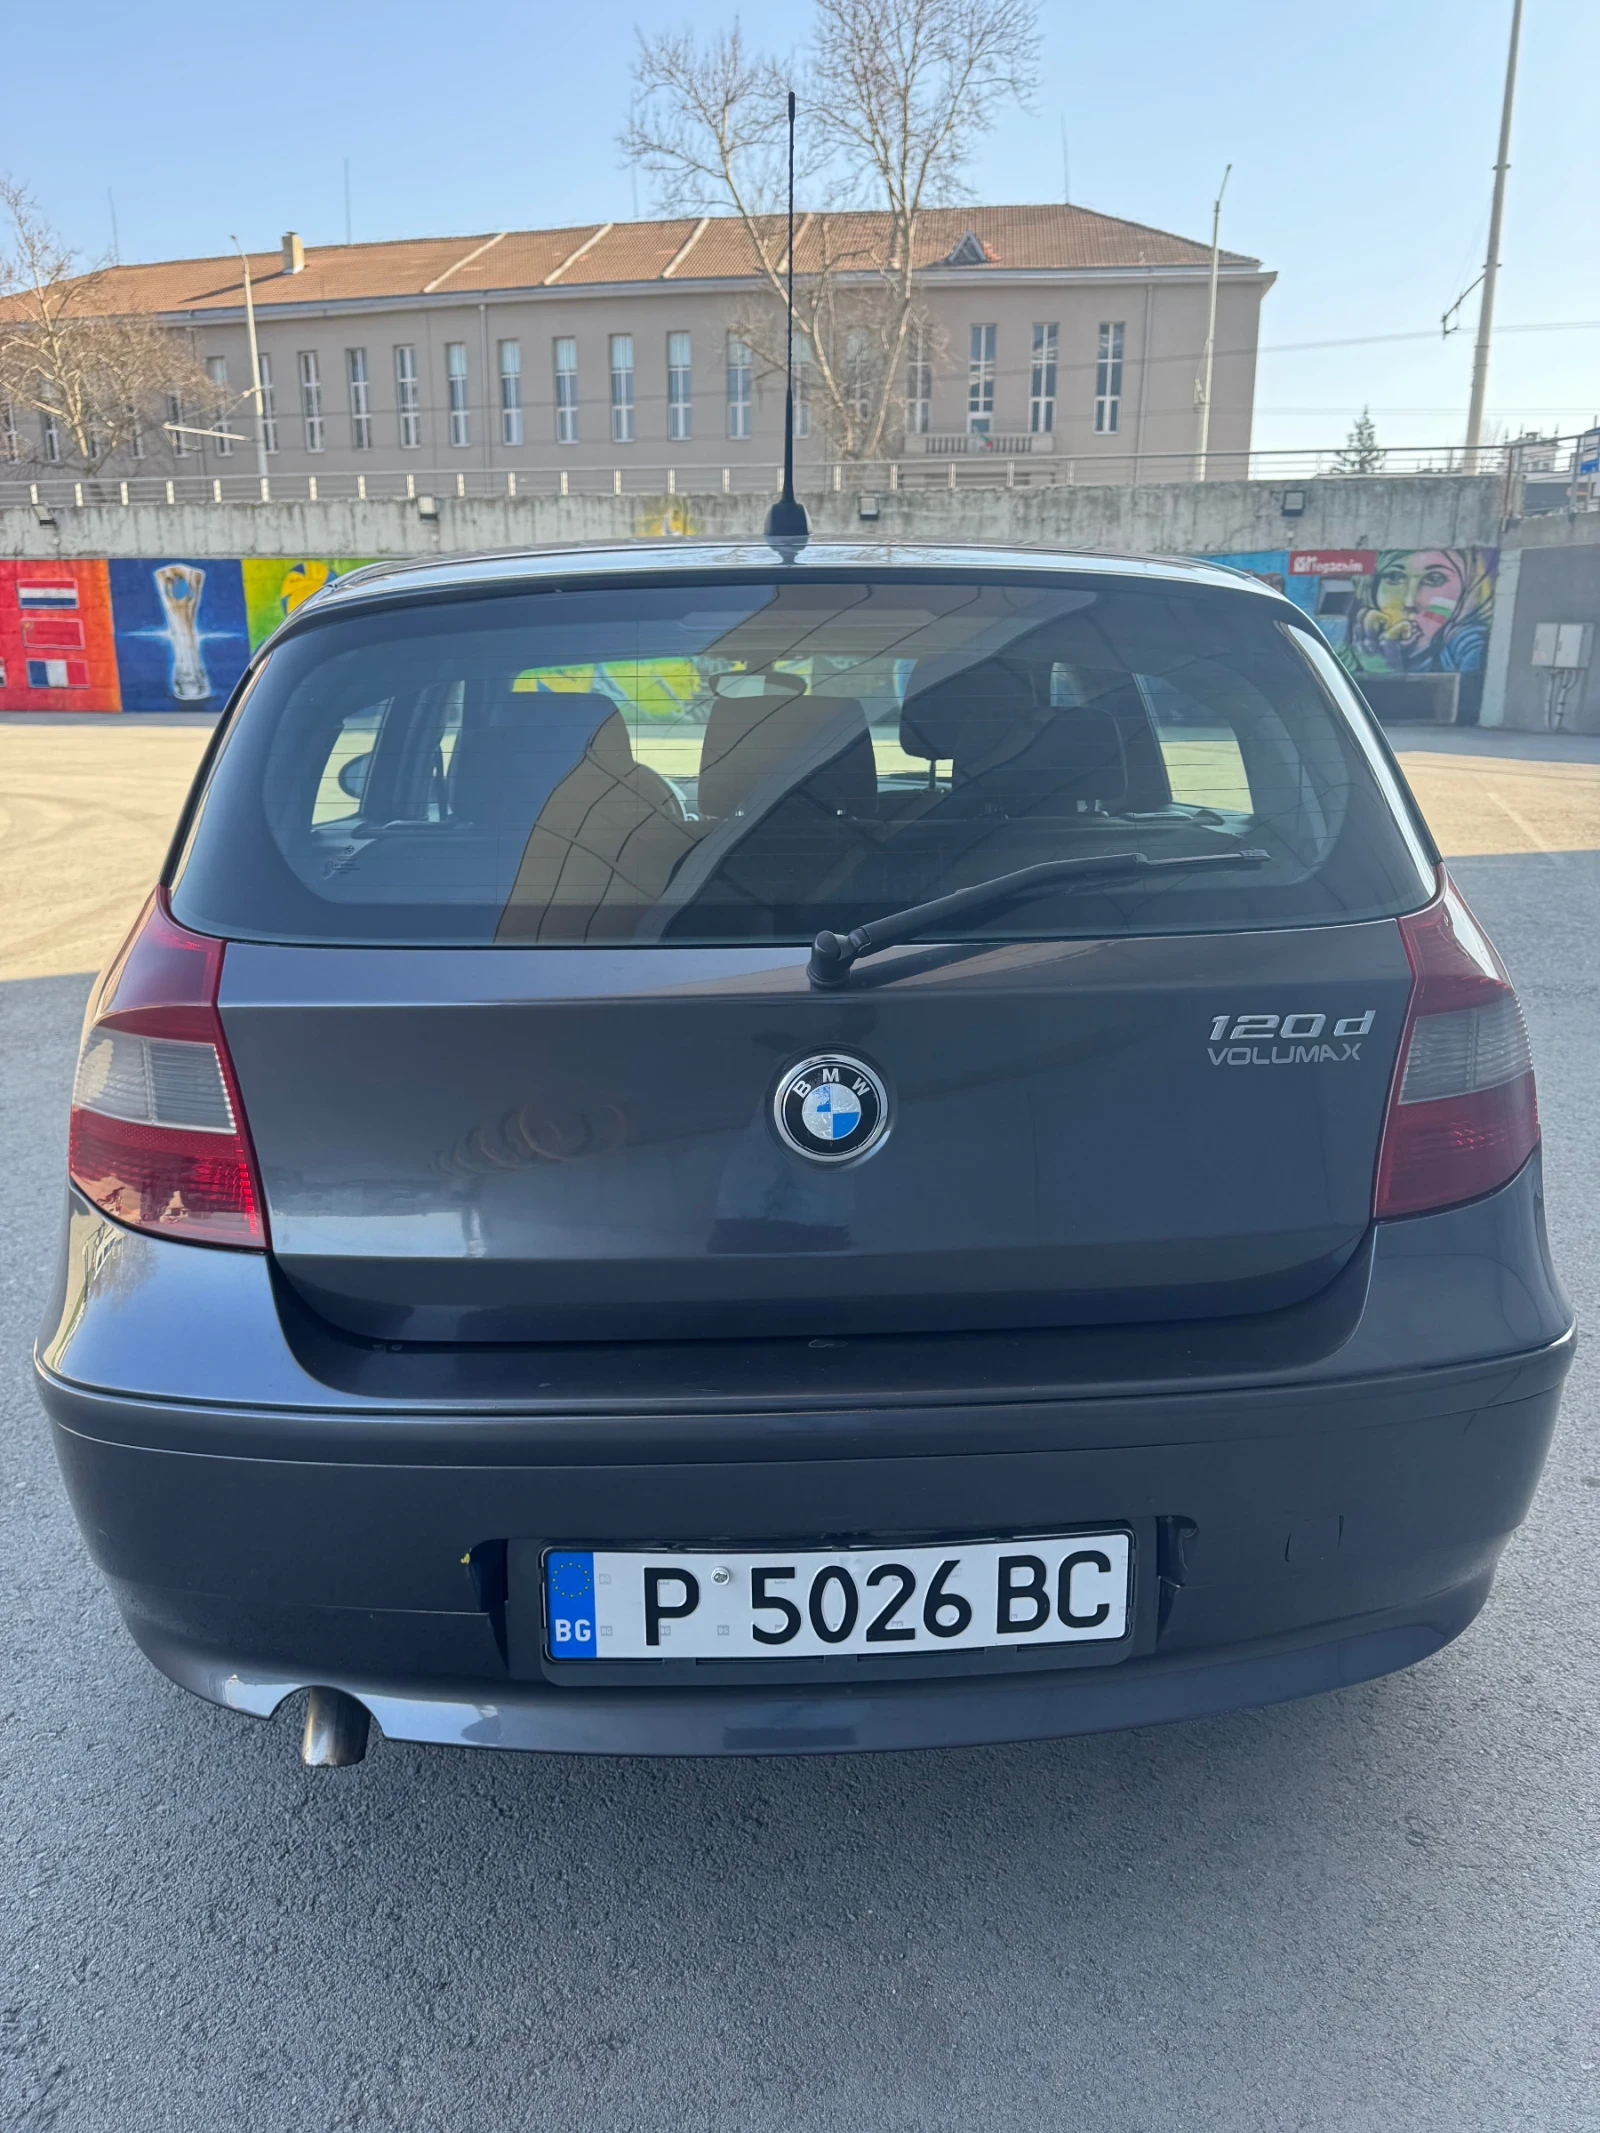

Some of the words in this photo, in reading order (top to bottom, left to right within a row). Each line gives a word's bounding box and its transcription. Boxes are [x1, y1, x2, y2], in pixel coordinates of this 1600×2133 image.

[1207, 1042, 1363, 1066] VOLUMAX
[792, 1067, 871, 1099] BMW
[643, 1567, 700, 1646] P
[750, 1559, 973, 1646] 5026
[996, 1549, 1112, 1635] BC
[554, 1618, 592, 1642] BG
